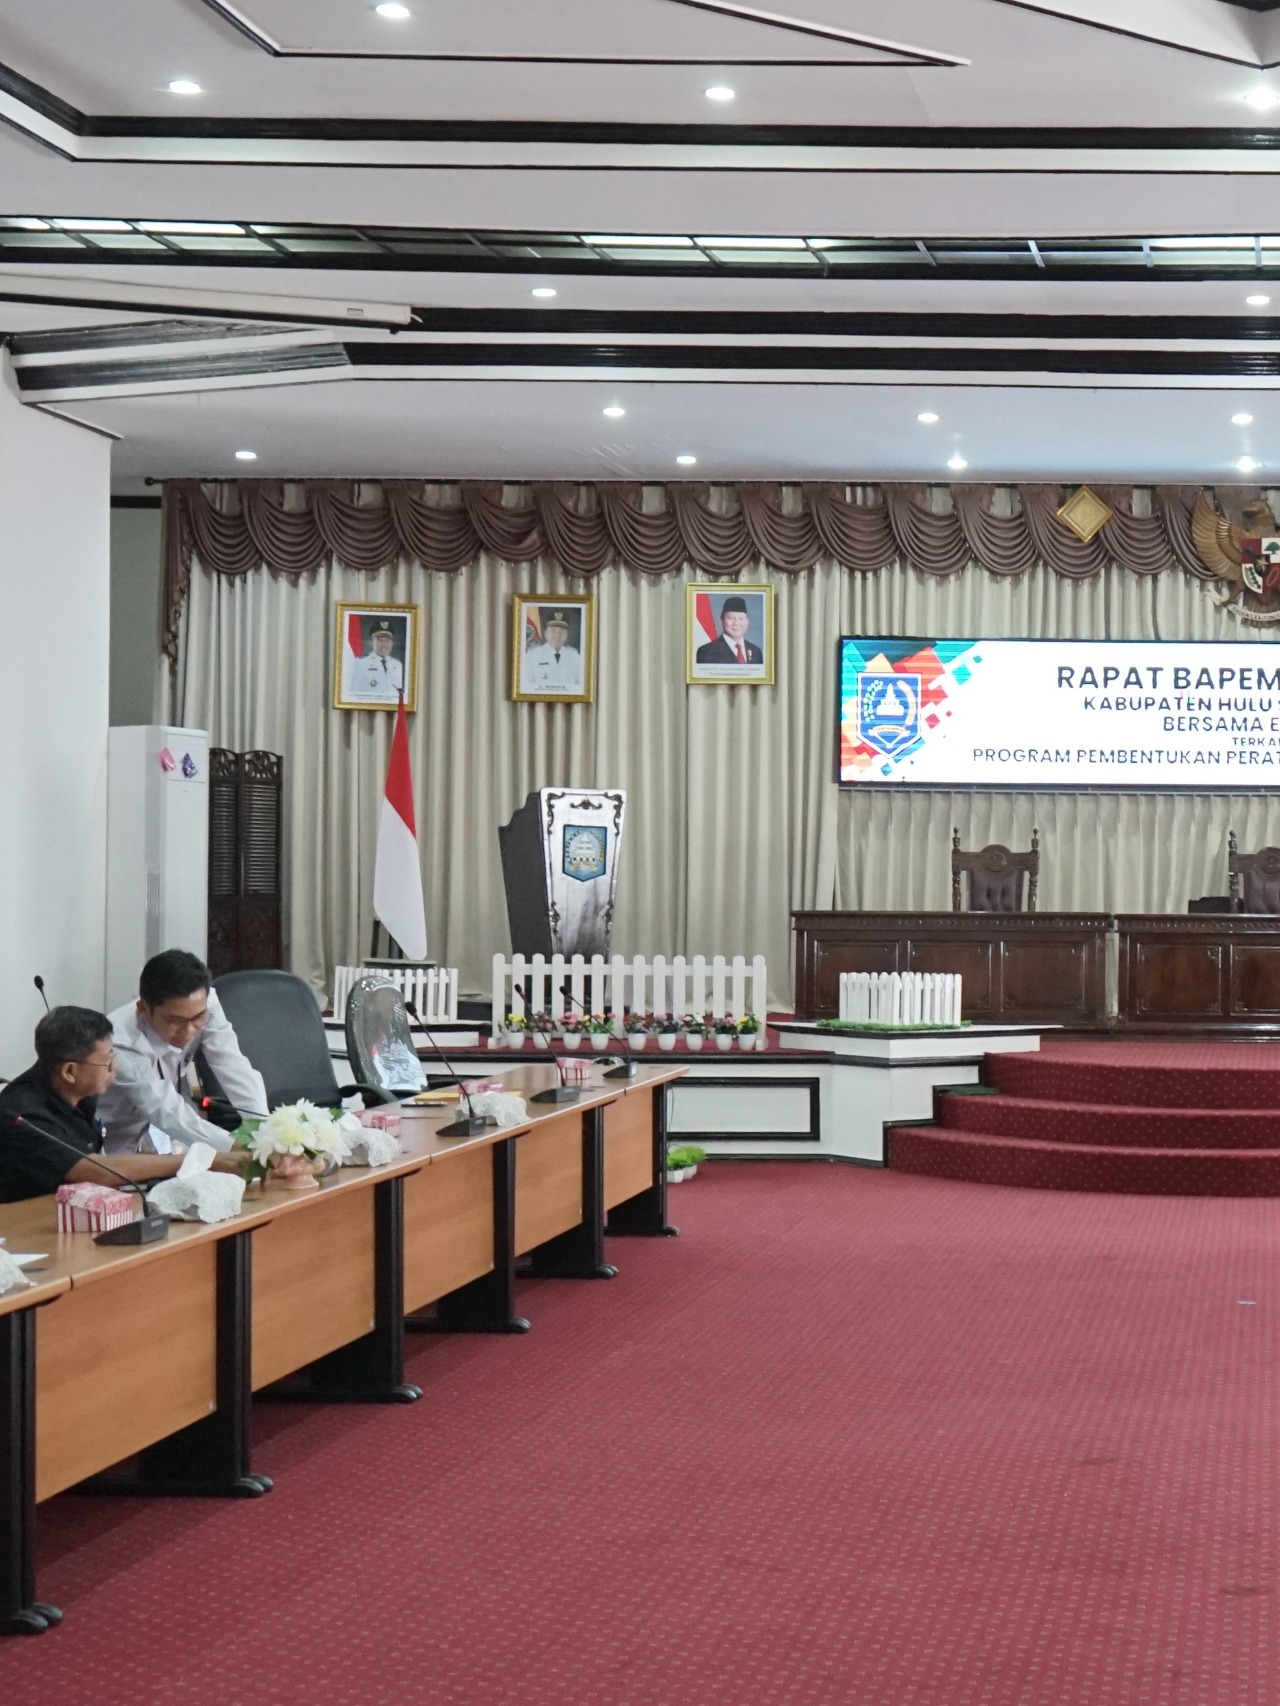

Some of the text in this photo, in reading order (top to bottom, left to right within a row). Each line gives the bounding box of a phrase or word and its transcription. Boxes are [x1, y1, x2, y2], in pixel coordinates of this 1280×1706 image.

[1057, 665, 1164, 690] RAPAT
[1083, 695, 1212, 712] KABUPATEN
[1218, 697, 1273, 713] HULU
[1163, 716, 1264, 732] BERSAMA
[973, 748, 1071, 763] PROGRAM
[1076, 749, 1221, 765] PEMBENTUKAN
